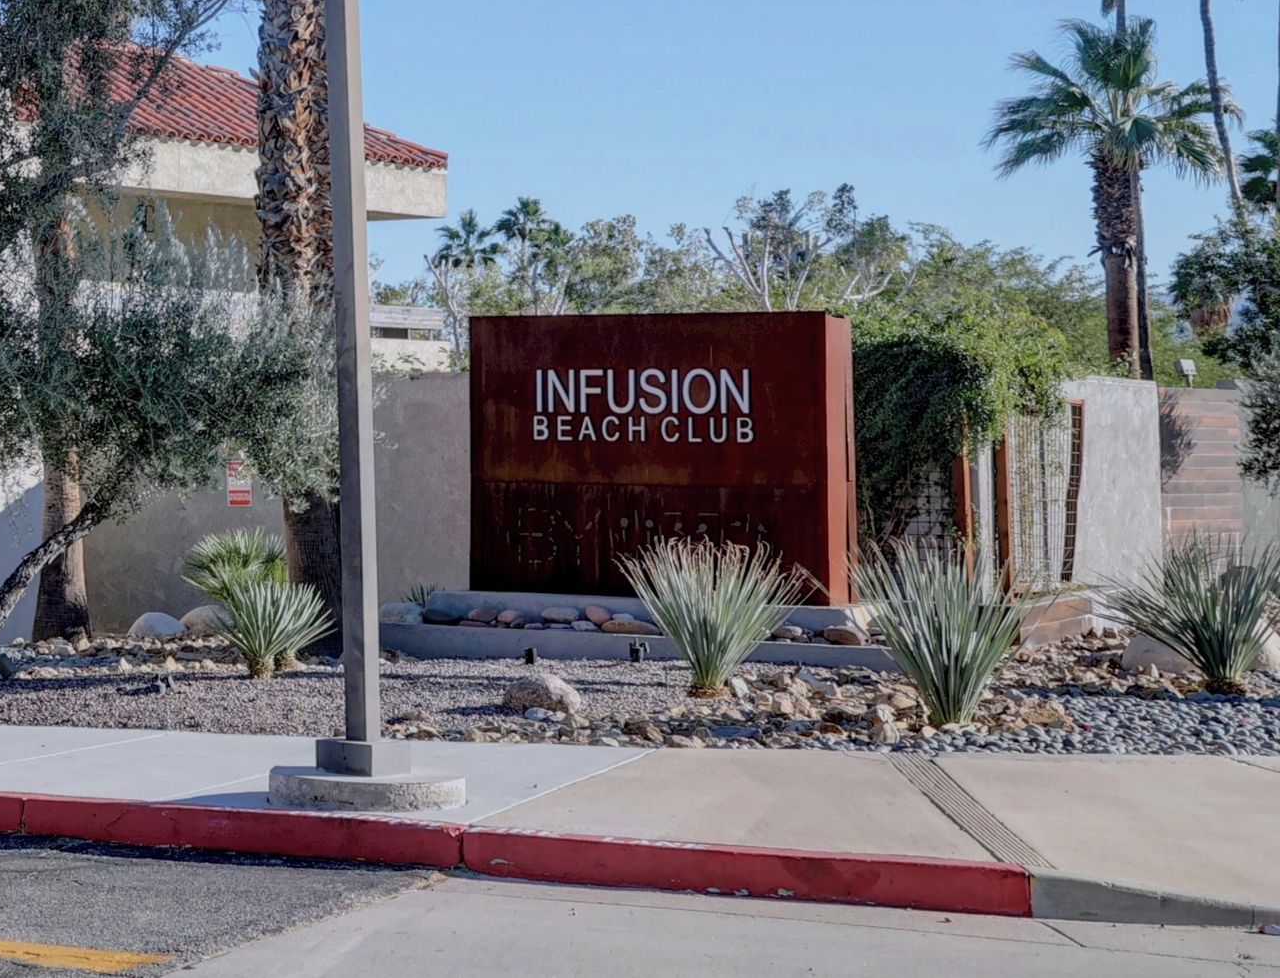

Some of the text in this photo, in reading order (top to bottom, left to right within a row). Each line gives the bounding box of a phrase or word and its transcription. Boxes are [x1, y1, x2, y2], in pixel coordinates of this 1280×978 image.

[536, 368, 750, 415] INFUSION
[533, 416, 754, 443] BEACH CLUB
